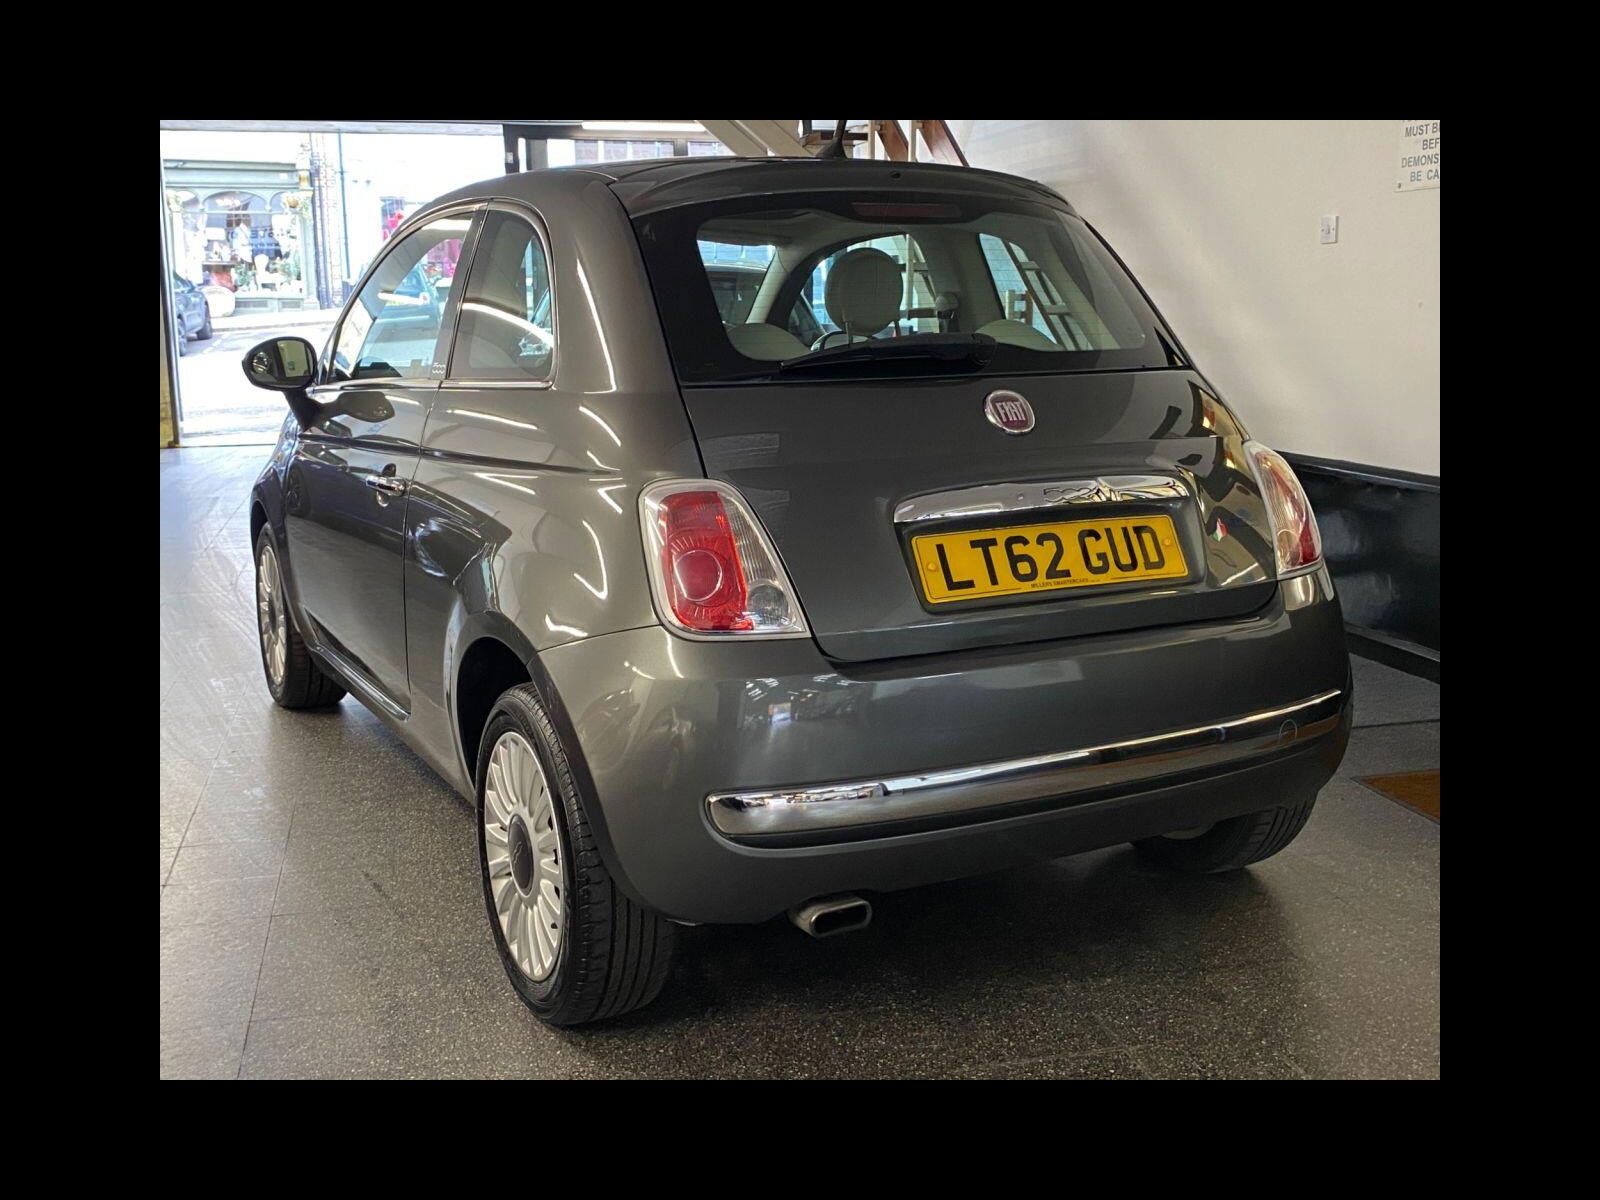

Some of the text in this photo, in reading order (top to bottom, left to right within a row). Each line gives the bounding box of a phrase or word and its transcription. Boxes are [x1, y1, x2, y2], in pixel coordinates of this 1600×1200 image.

[1405, 122, 1440, 137] MUST B
[1401, 153, 1439, 168] DEMONS
[1410, 169, 1440, 182] BE CA
[995, 401, 1026, 422] FIAT
[935, 525, 1165, 591] LT62 GUD
